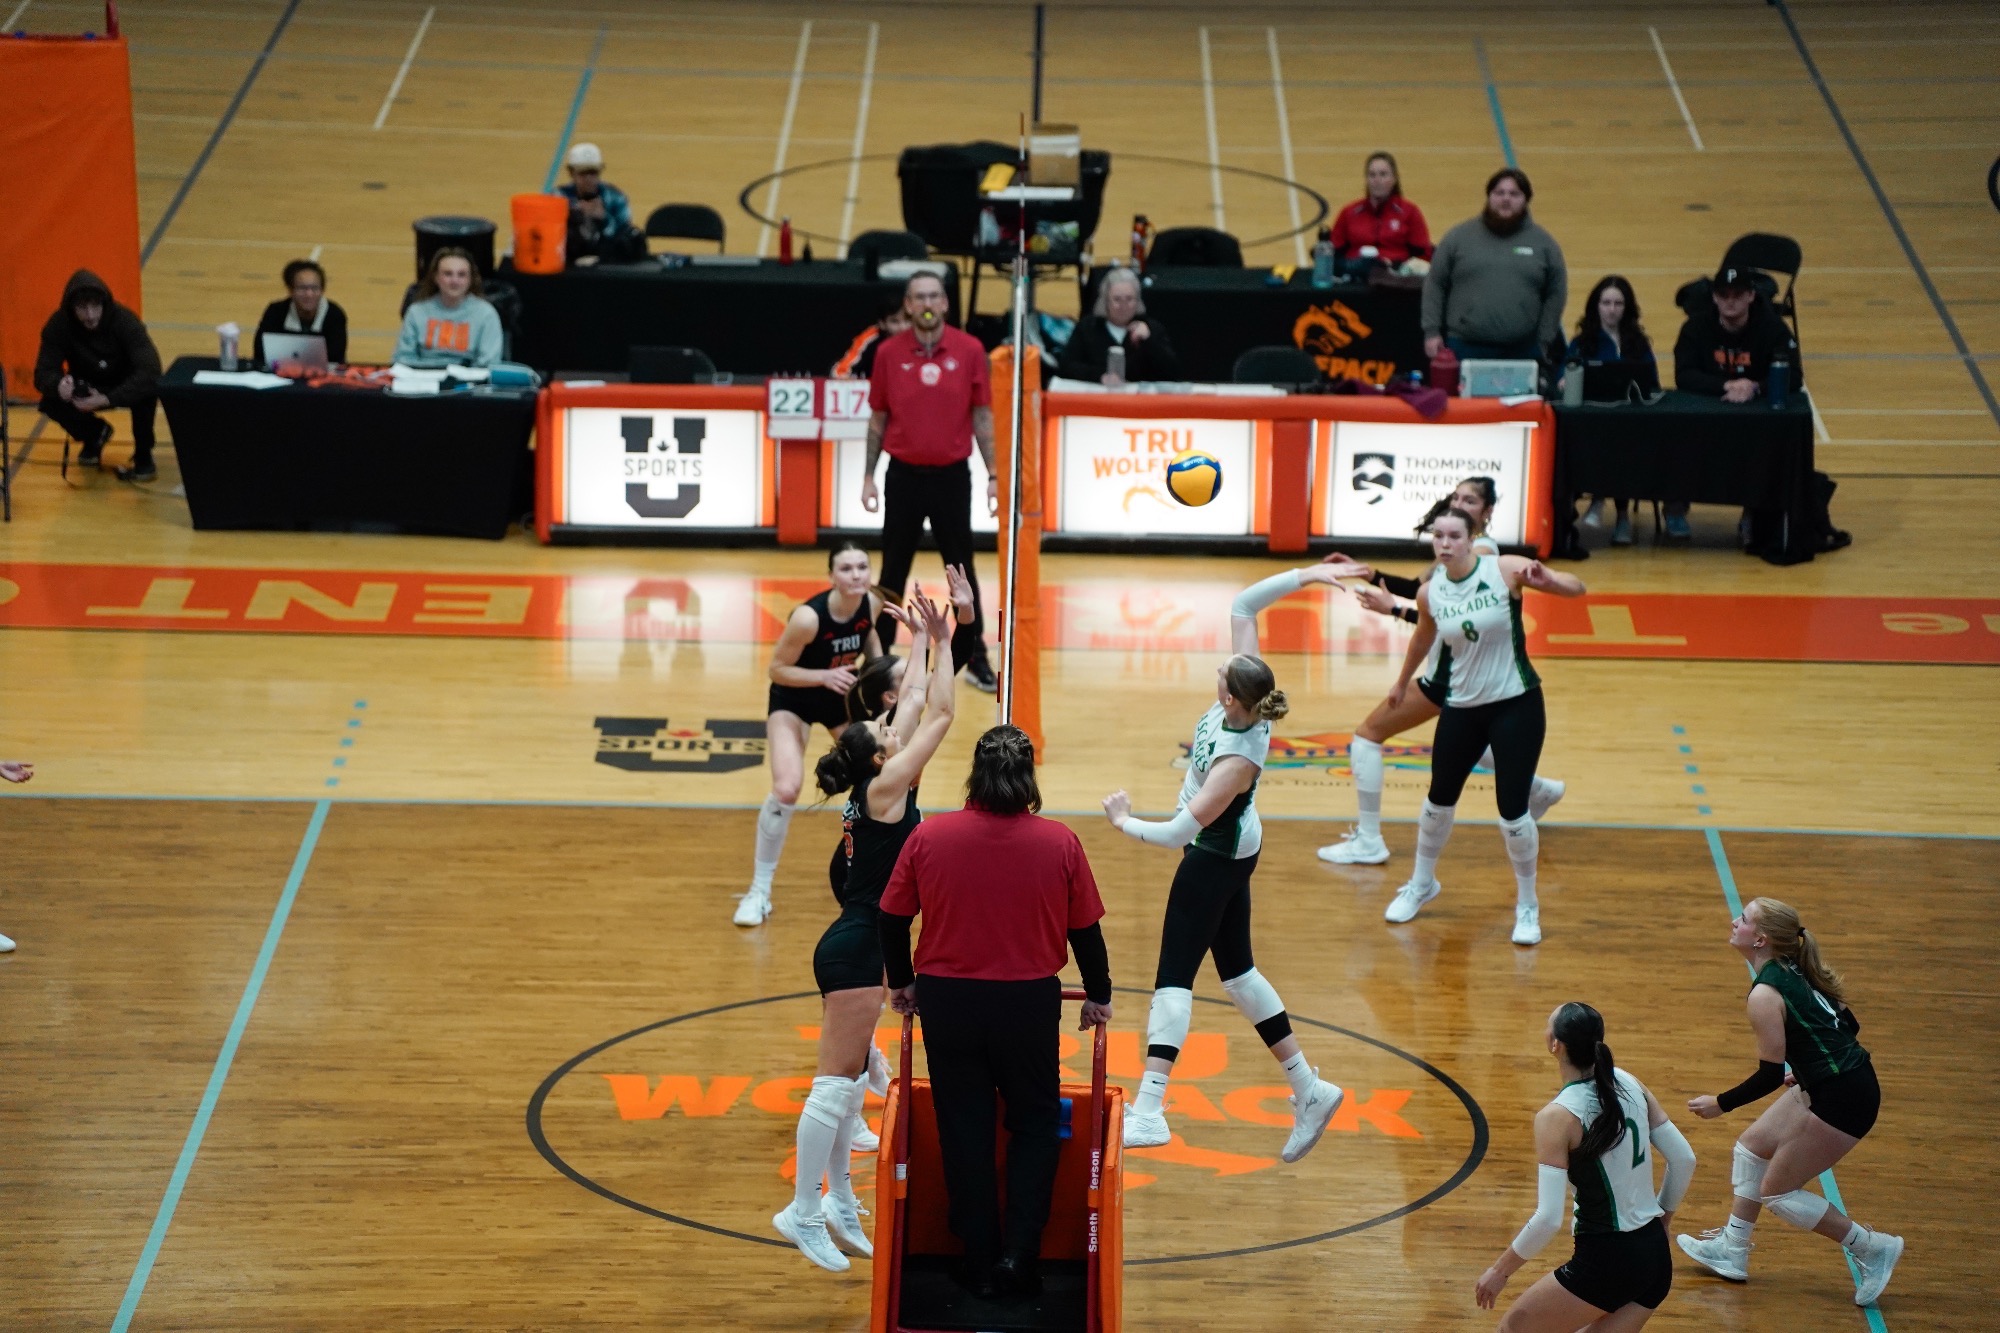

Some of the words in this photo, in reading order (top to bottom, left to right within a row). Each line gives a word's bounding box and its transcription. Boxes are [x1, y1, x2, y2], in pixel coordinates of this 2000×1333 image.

[774, 389, 810, 413] 22
[831, 389, 866, 415] 17
[1122, 428, 1194, 453] TRU
[624, 458, 703, 477] SPORTS
[1404, 456, 1502, 472] THOMPSON
[1436, 593, 1500, 621] CASCADES
[831, 633, 861, 653] TRU
[1461, 619, 1480, 643] 8
[599, 736, 766, 752] SPORTS
